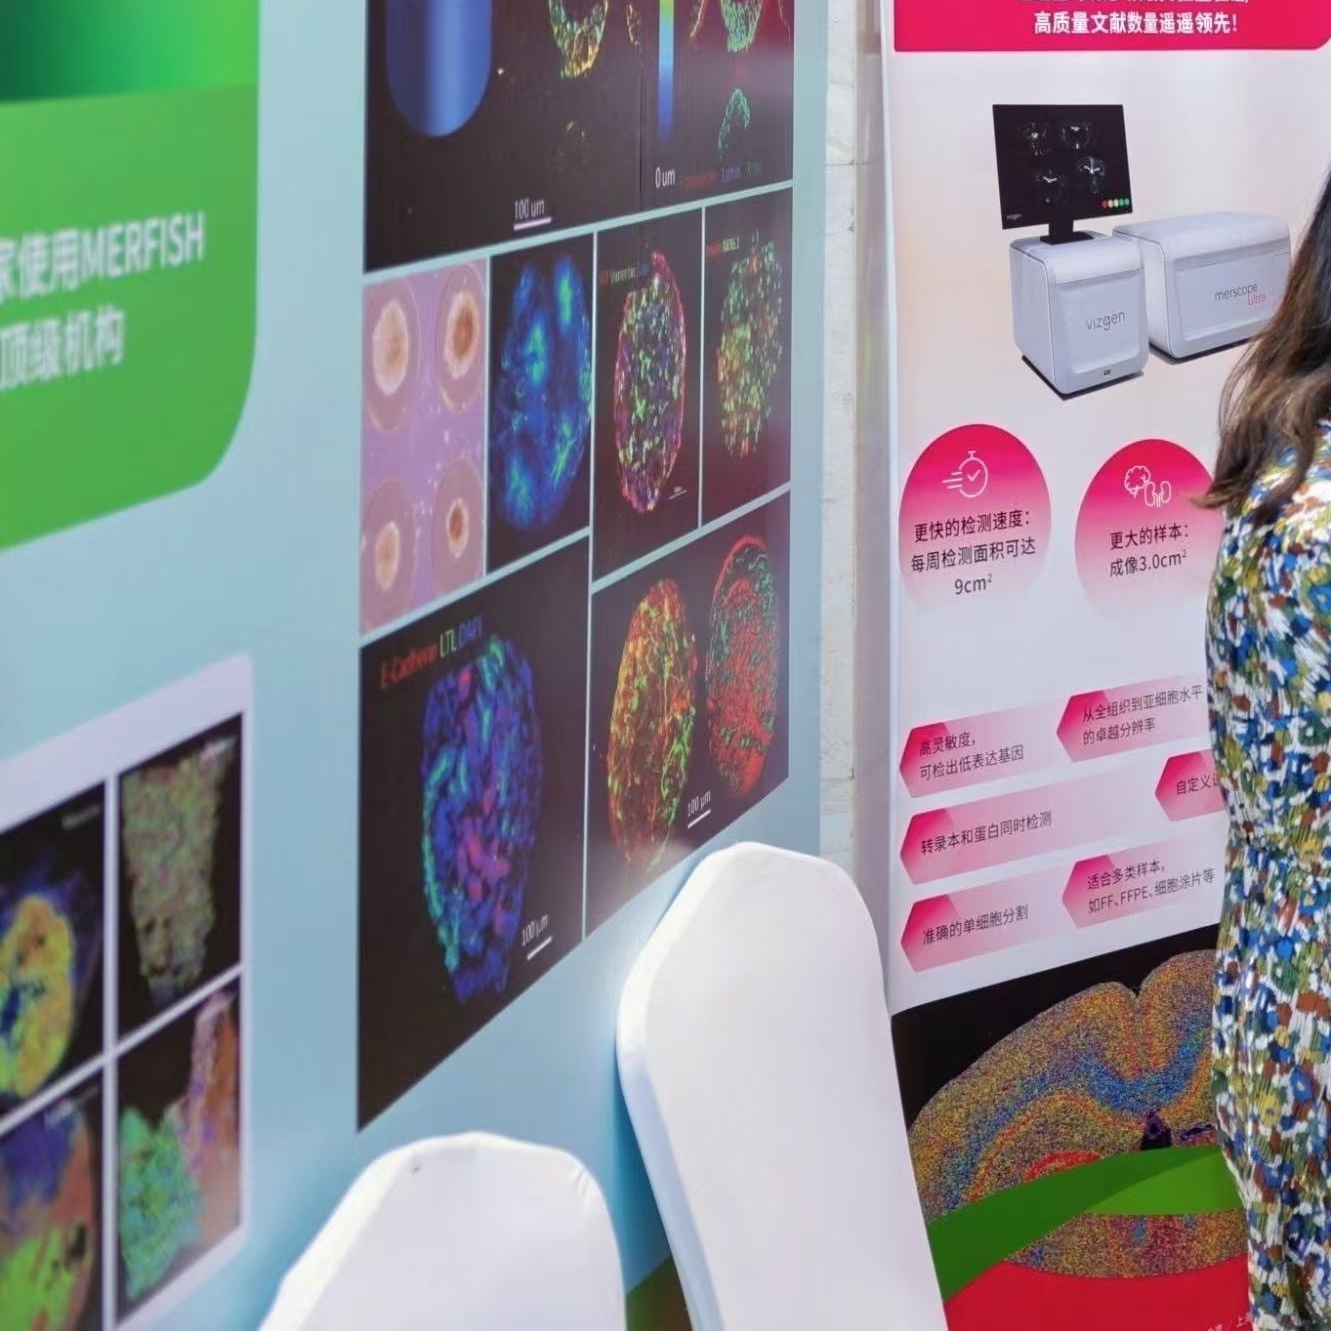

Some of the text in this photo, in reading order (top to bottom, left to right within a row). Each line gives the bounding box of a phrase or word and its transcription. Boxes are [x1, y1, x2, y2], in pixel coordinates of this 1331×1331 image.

[1086, 309, 1127, 332] vizgen
[911, 536, 1037, 574] 每周检测面积可达
[1082, 684, 1204, 723] 从全组织到亚细胞水平
[1082, 717, 1156, 746] 的卓越分辨率
[919, 744, 1025, 781] 可检出低表达基因
[920, 810, 1053, 857] 转录本和蛋白同时检测
[921, 903, 1029, 946] 准确的单细胞分割
